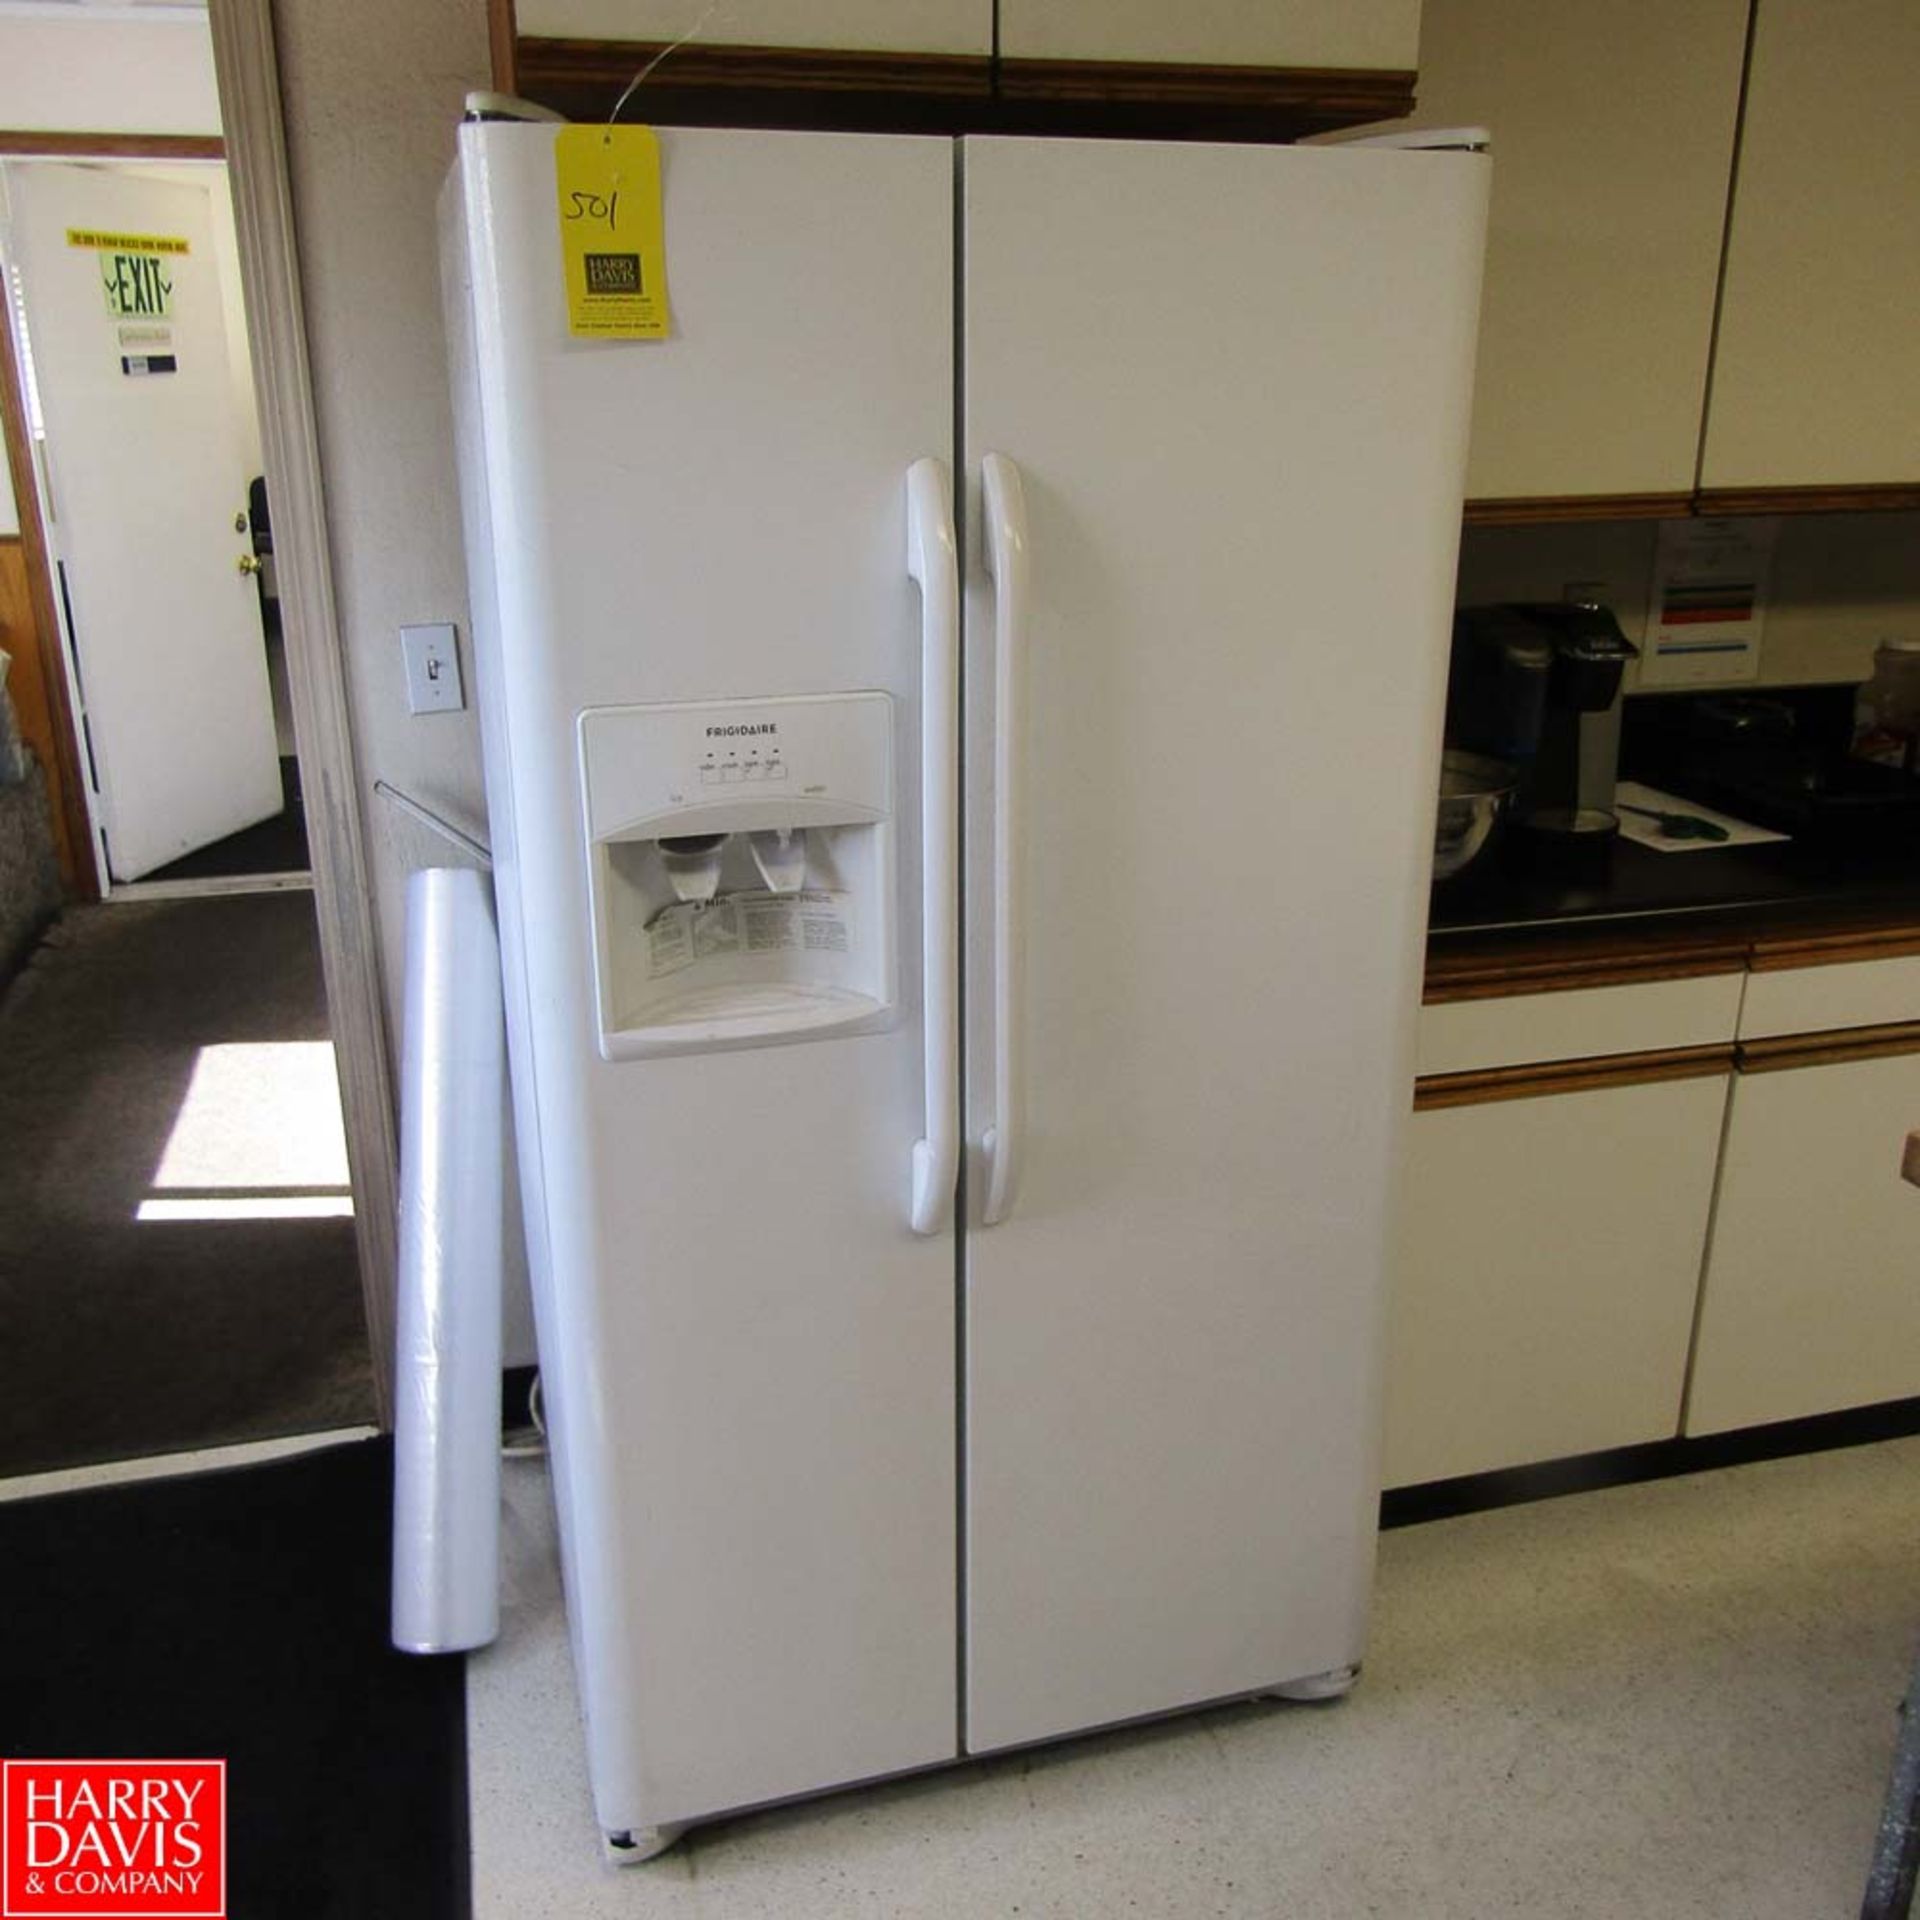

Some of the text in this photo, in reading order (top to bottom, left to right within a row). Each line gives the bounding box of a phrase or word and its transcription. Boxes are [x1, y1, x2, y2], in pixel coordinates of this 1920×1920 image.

[566, 191, 617, 231] 501
[588, 257, 634, 270] HARRY
[590, 269, 635, 282] DAVIS
[115, 255, 163, 313] EXIT
[706, 723, 778, 737] FRIGIDAIRE
